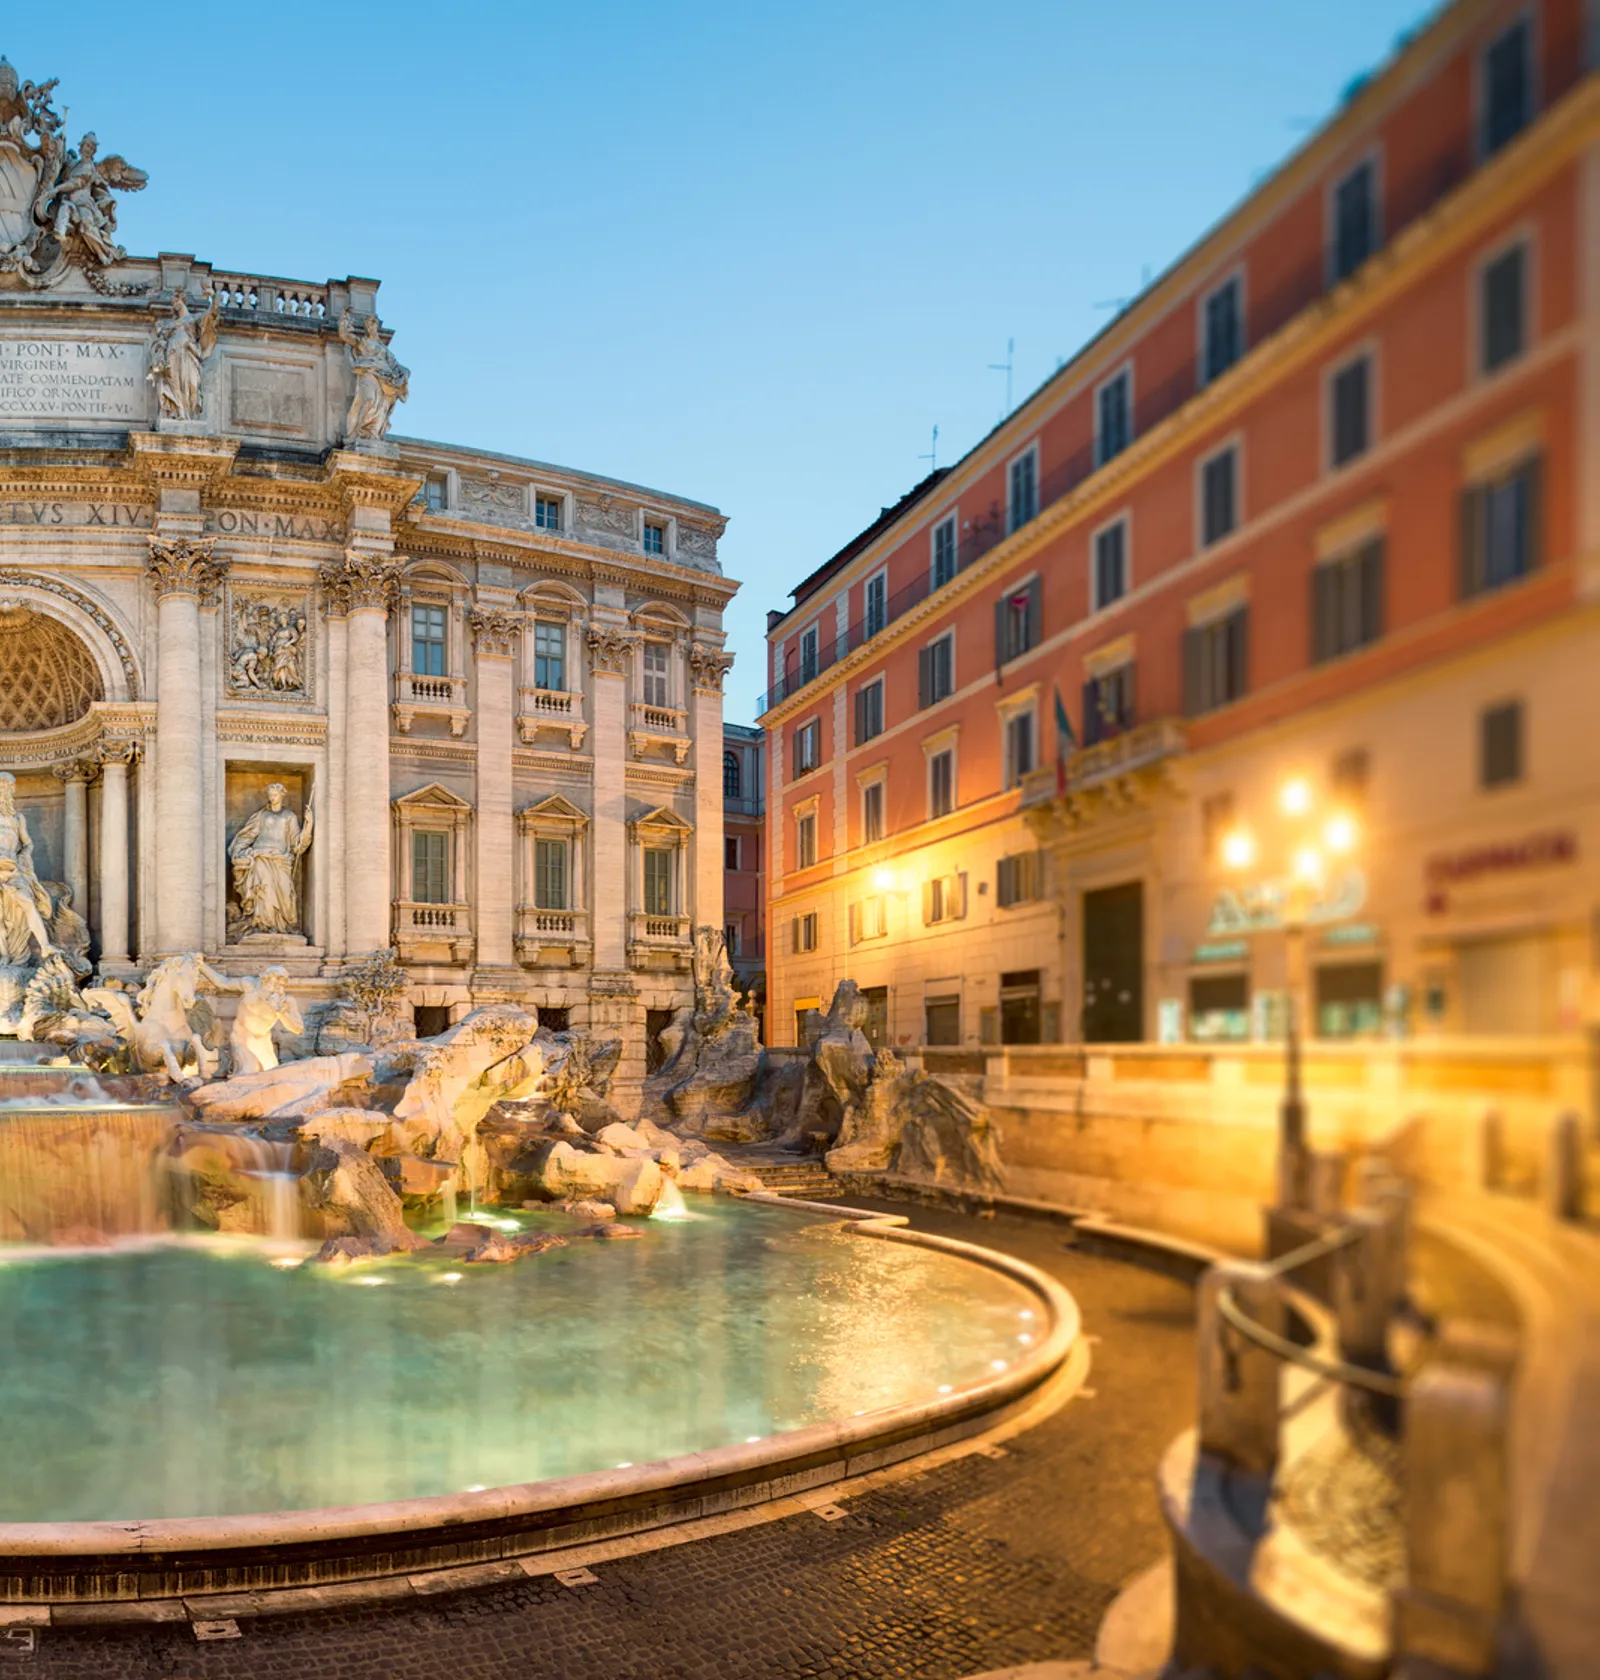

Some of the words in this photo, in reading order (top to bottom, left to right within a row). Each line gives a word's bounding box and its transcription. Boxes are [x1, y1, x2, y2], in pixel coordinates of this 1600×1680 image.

[0, 360, 68, 371] VIRGINEM
[30, 374, 134, 388] COMMENDATAM
[41, 387, 103, 399] ORNAVIT
